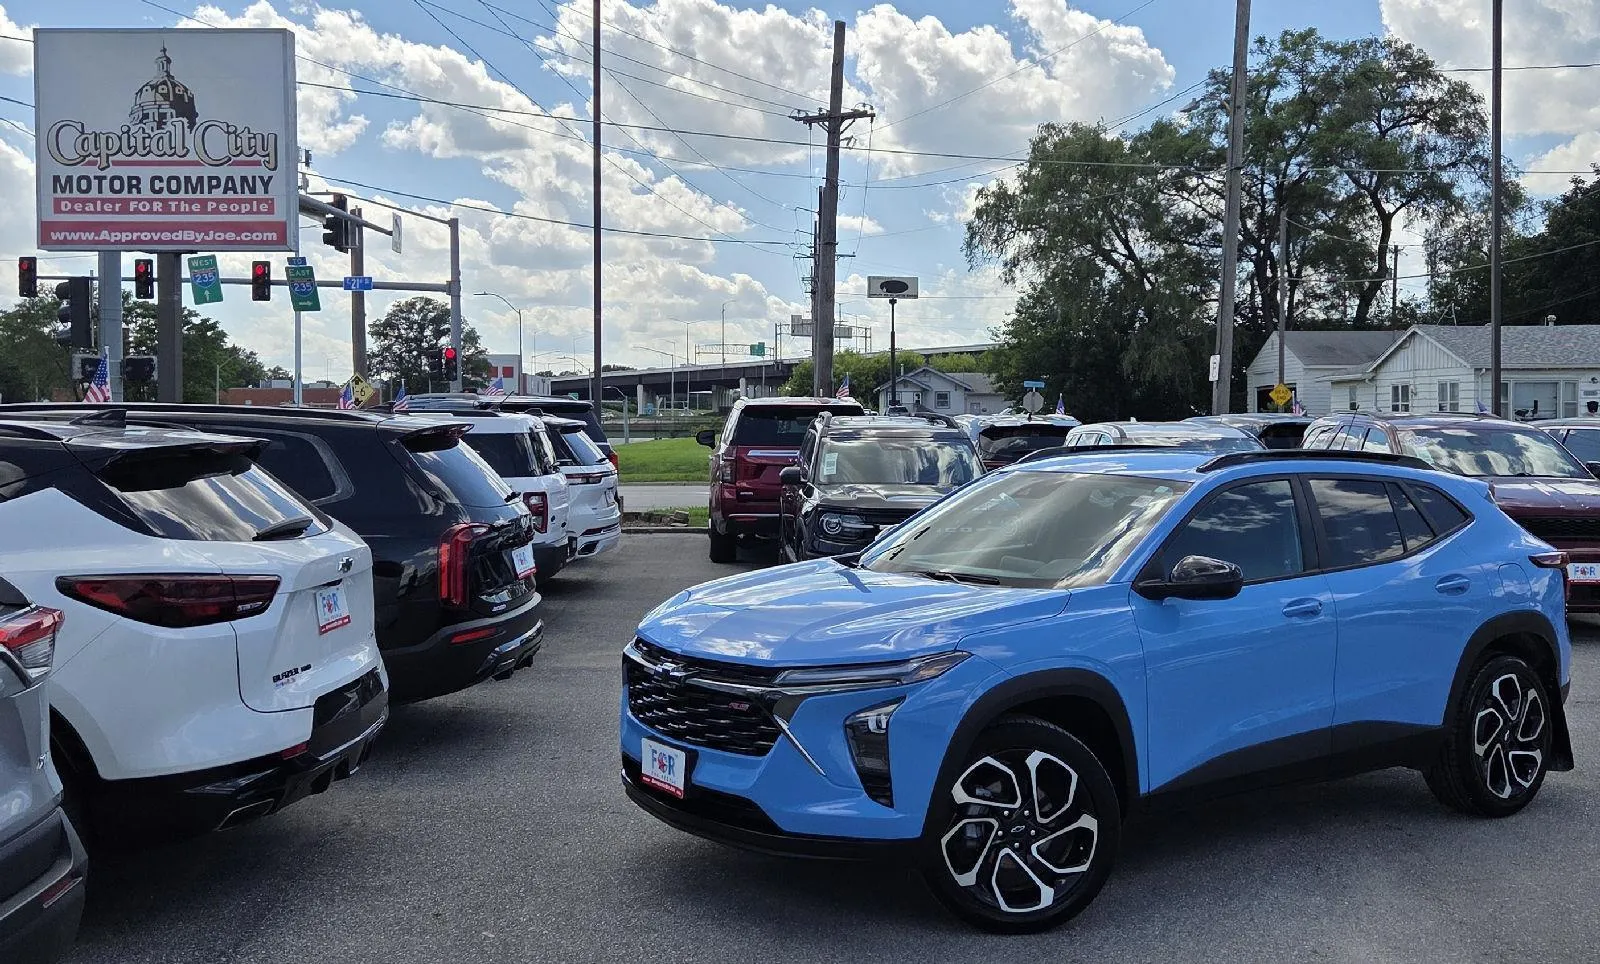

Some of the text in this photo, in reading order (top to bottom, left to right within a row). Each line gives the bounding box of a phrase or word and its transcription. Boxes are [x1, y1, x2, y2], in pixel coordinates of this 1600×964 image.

[47, 119, 278, 171] Capital City
[52, 174, 274, 195] MOTOR COMPANY
[60, 200, 122, 213] Dealer
[129, 200, 163, 213] FOR
[168, 200, 201, 213] The
[50, 229, 278, 243] www.ApprovedByJoe.com
[190, 259, 213, 267] WEST
[195, 273, 215, 283] 235
[288, 268, 310, 277] EAST
[293, 282, 313, 292] 235
